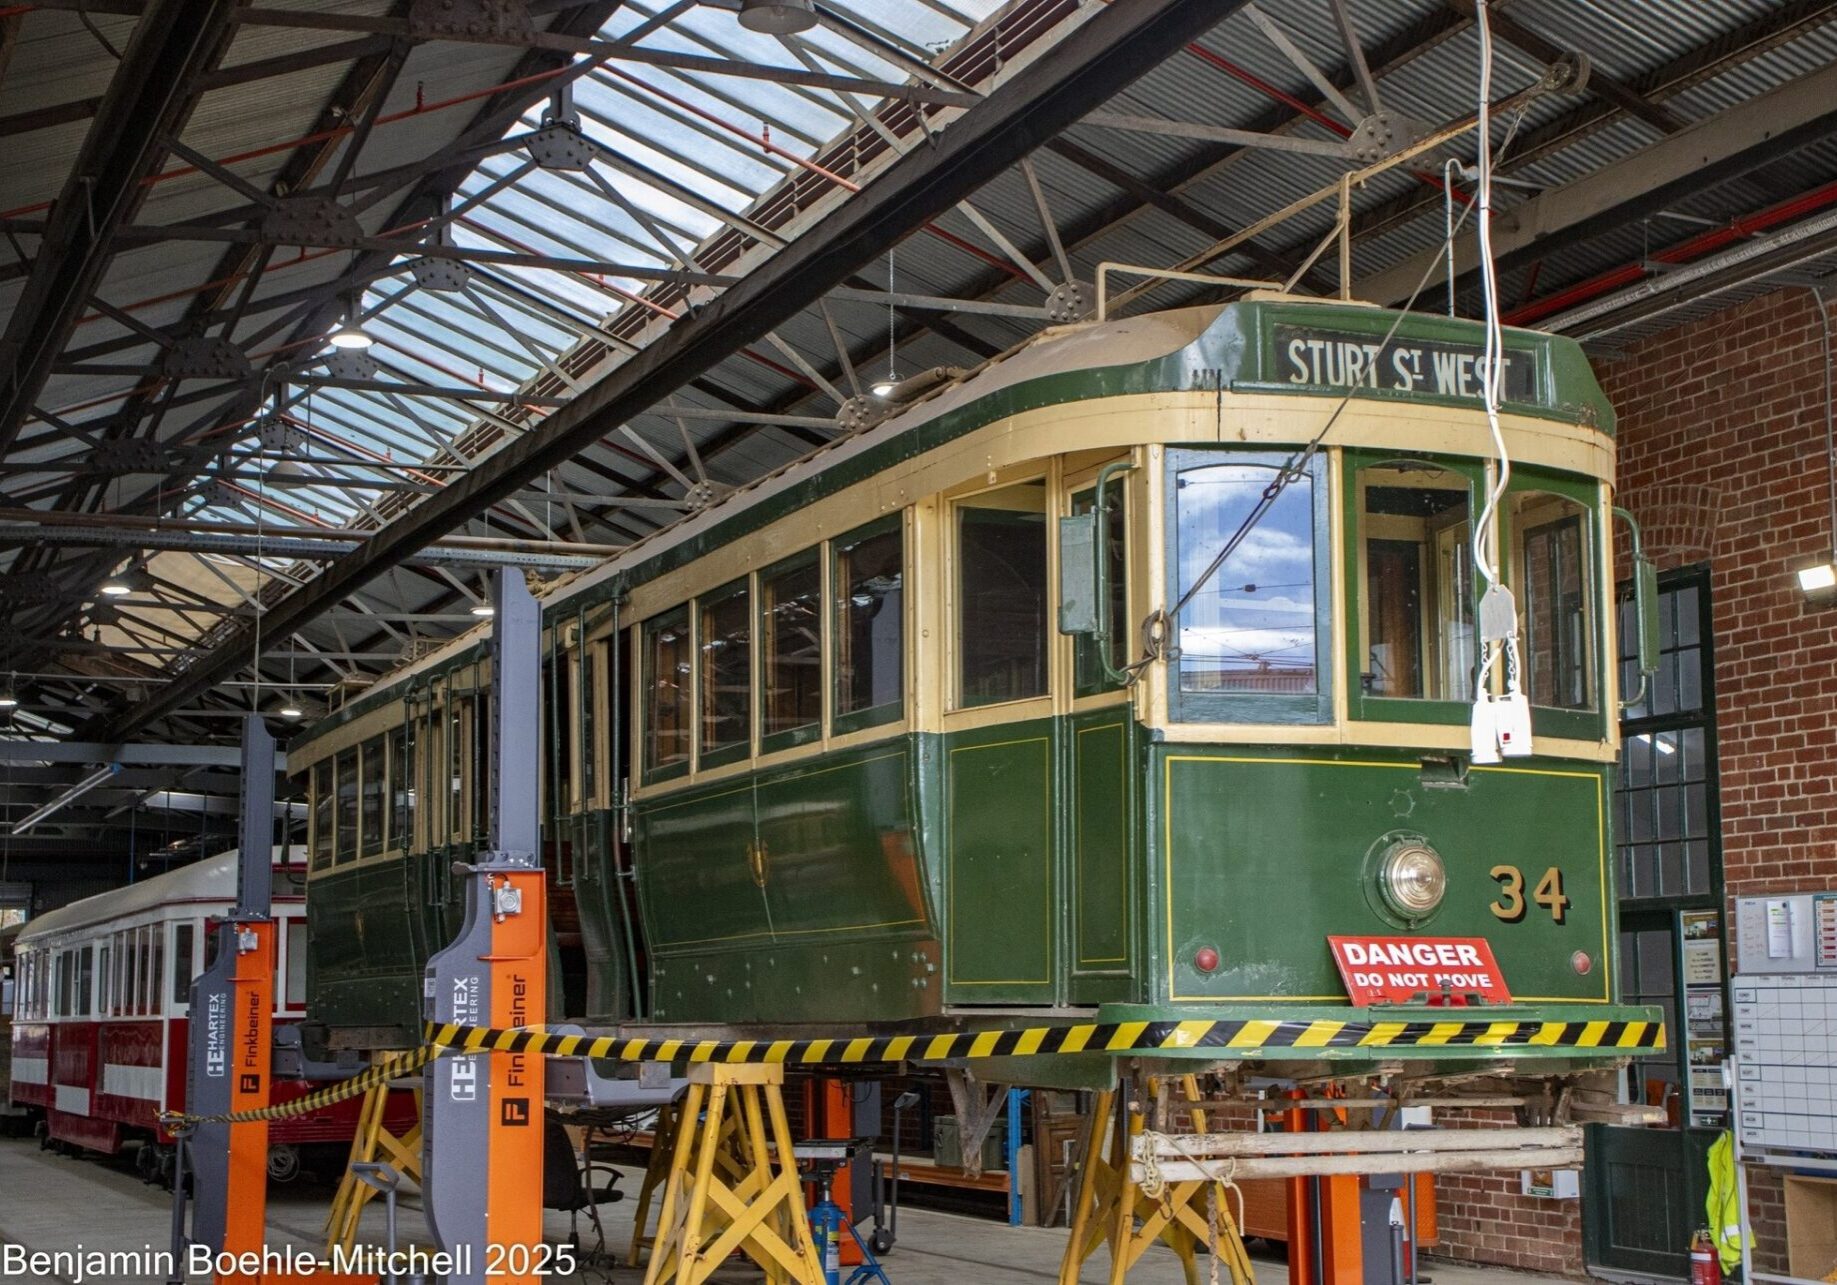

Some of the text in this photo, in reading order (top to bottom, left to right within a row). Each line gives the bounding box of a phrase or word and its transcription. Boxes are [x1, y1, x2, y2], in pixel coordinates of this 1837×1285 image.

[1288, 339, 1382, 388] STURT
[1433, 351, 1511, 401] WEST
[1490, 865, 1569, 924] 34
[1342, 943, 1484, 966] DANGER
[1353, 972, 1493, 988] DO NOT MOVE
[219, 993, 227, 1050] ENGINEERING
[244, 991, 259, 1067] Finkbeiner
